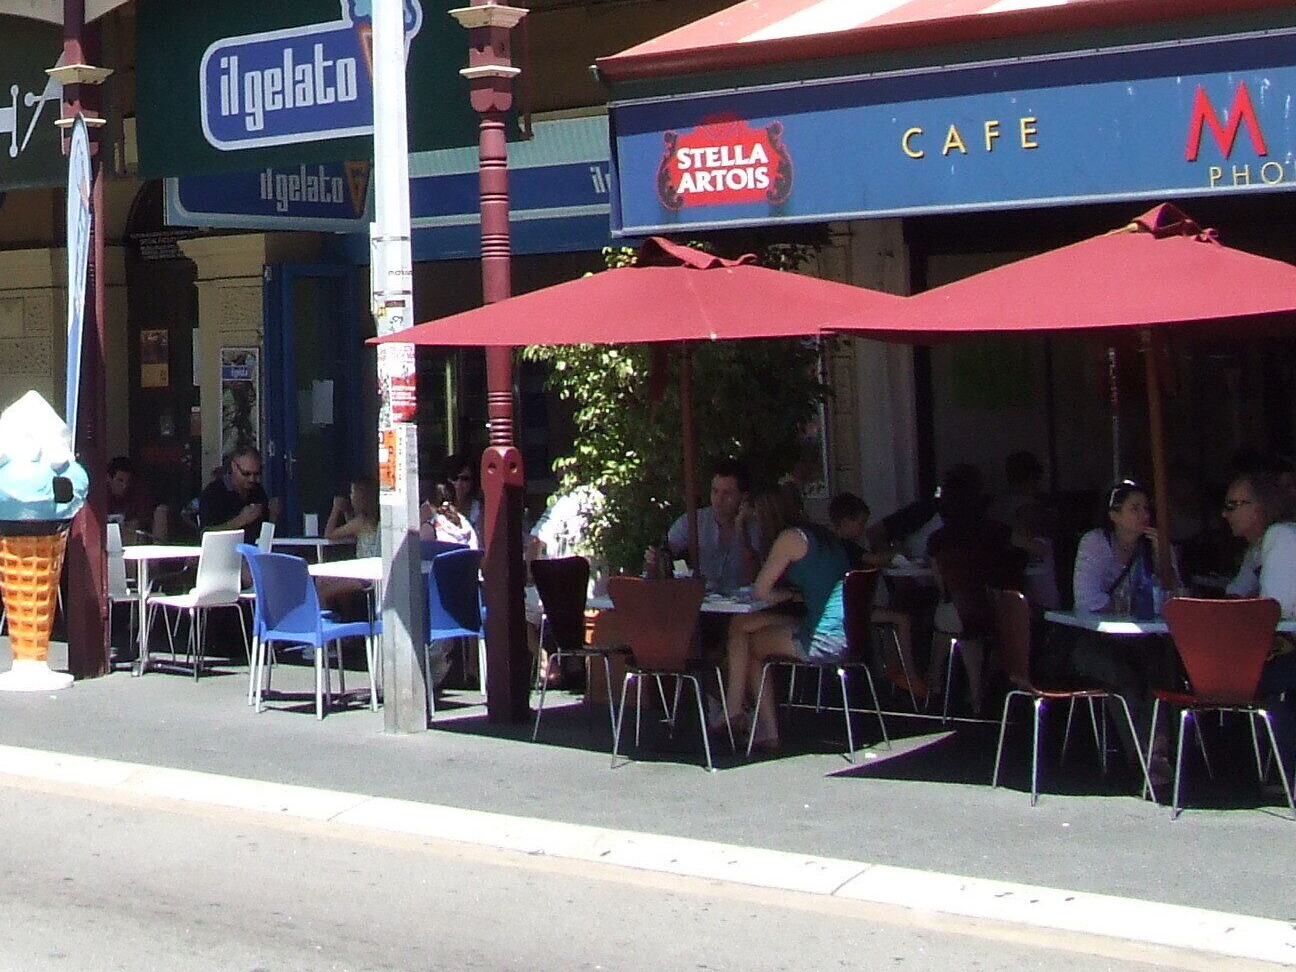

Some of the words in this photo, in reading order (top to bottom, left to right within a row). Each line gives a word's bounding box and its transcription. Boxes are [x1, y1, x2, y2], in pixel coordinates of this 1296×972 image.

[220, 55, 239, 116] il
[244, 43, 358, 131] gelato
[901, 117, 1039, 159] CAFE
[1185, 78, 1268, 162] M
[676, 142, 769, 170] STELLA
[1209, 161, 1296, 188] PHO
[275, 164, 344, 212] gelato
[676, 167, 770, 194] ARTOIS
